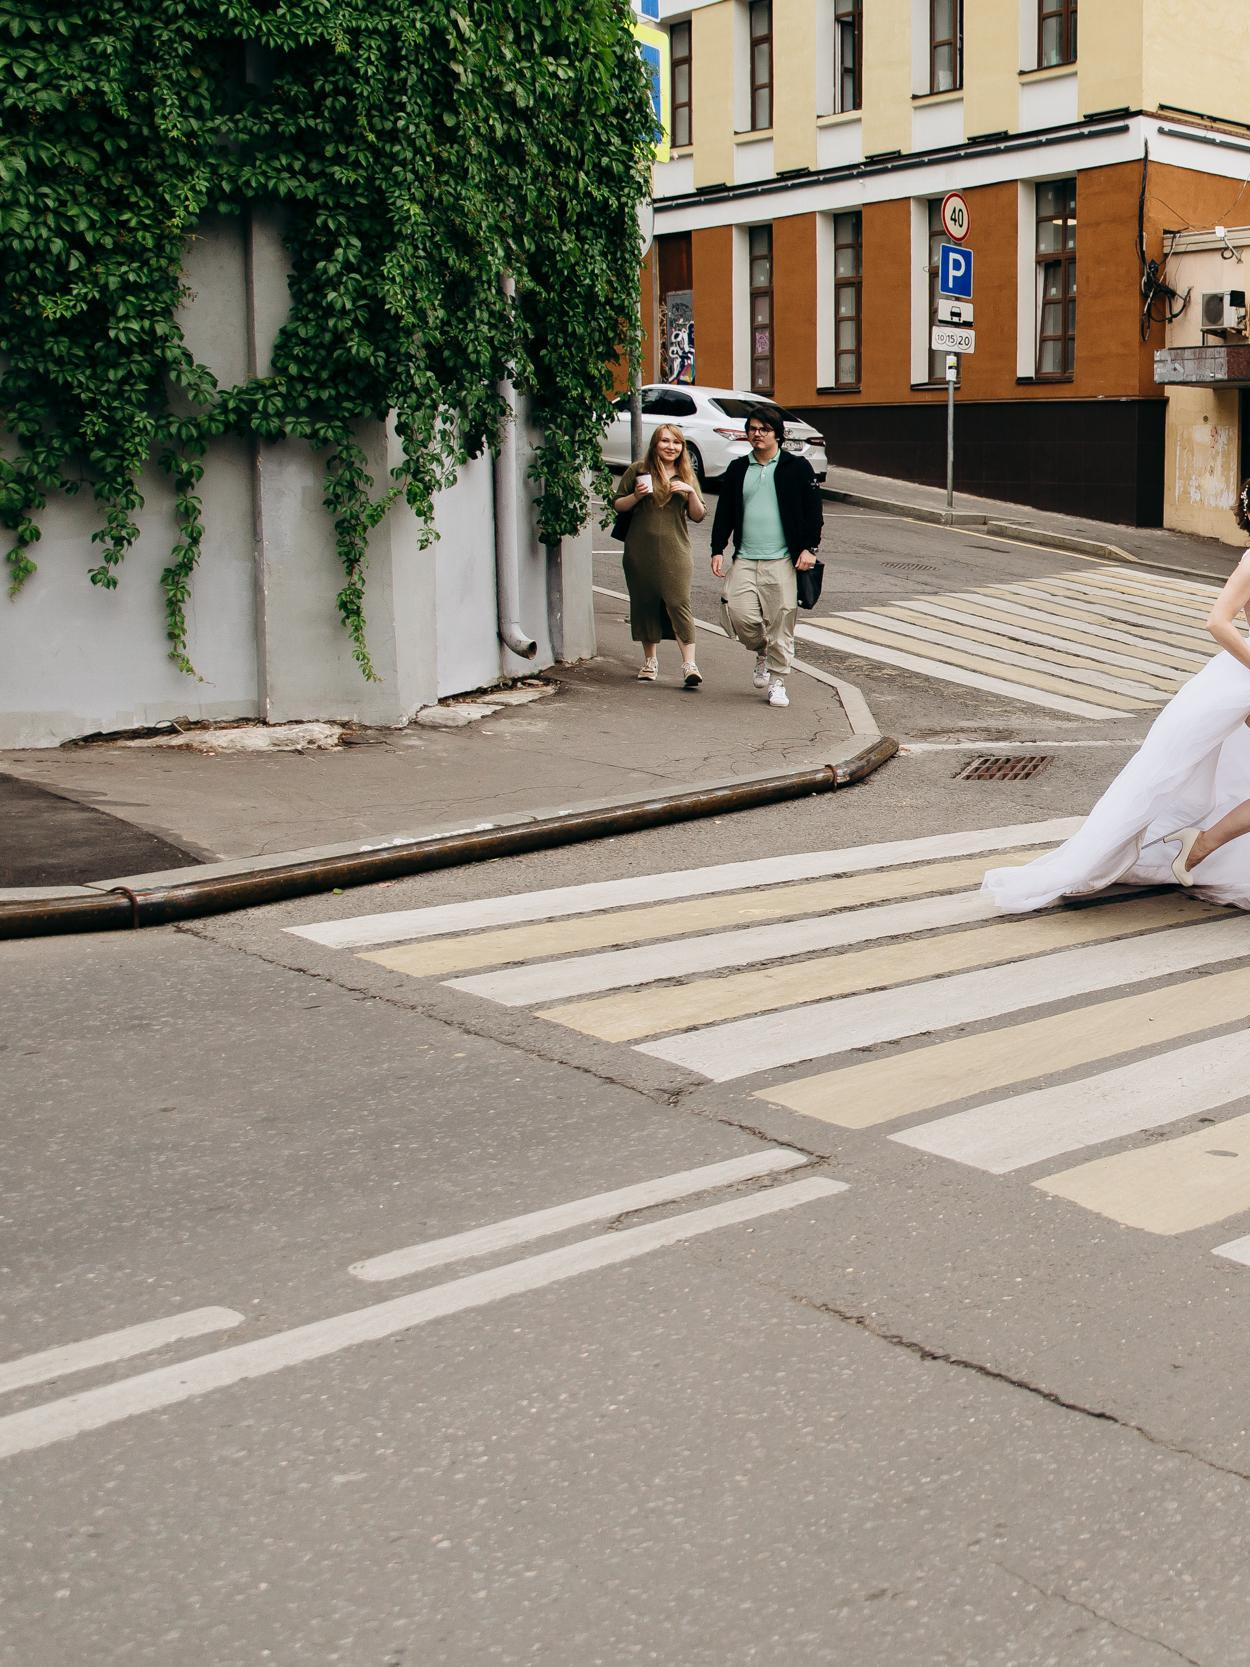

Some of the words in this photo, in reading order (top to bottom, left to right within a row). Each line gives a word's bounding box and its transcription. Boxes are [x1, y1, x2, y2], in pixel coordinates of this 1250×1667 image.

[950, 206, 964, 228] 40
[948, 252, 966, 288] P
[947, 334, 956, 344] 15
[958, 336, 970, 346] 20
